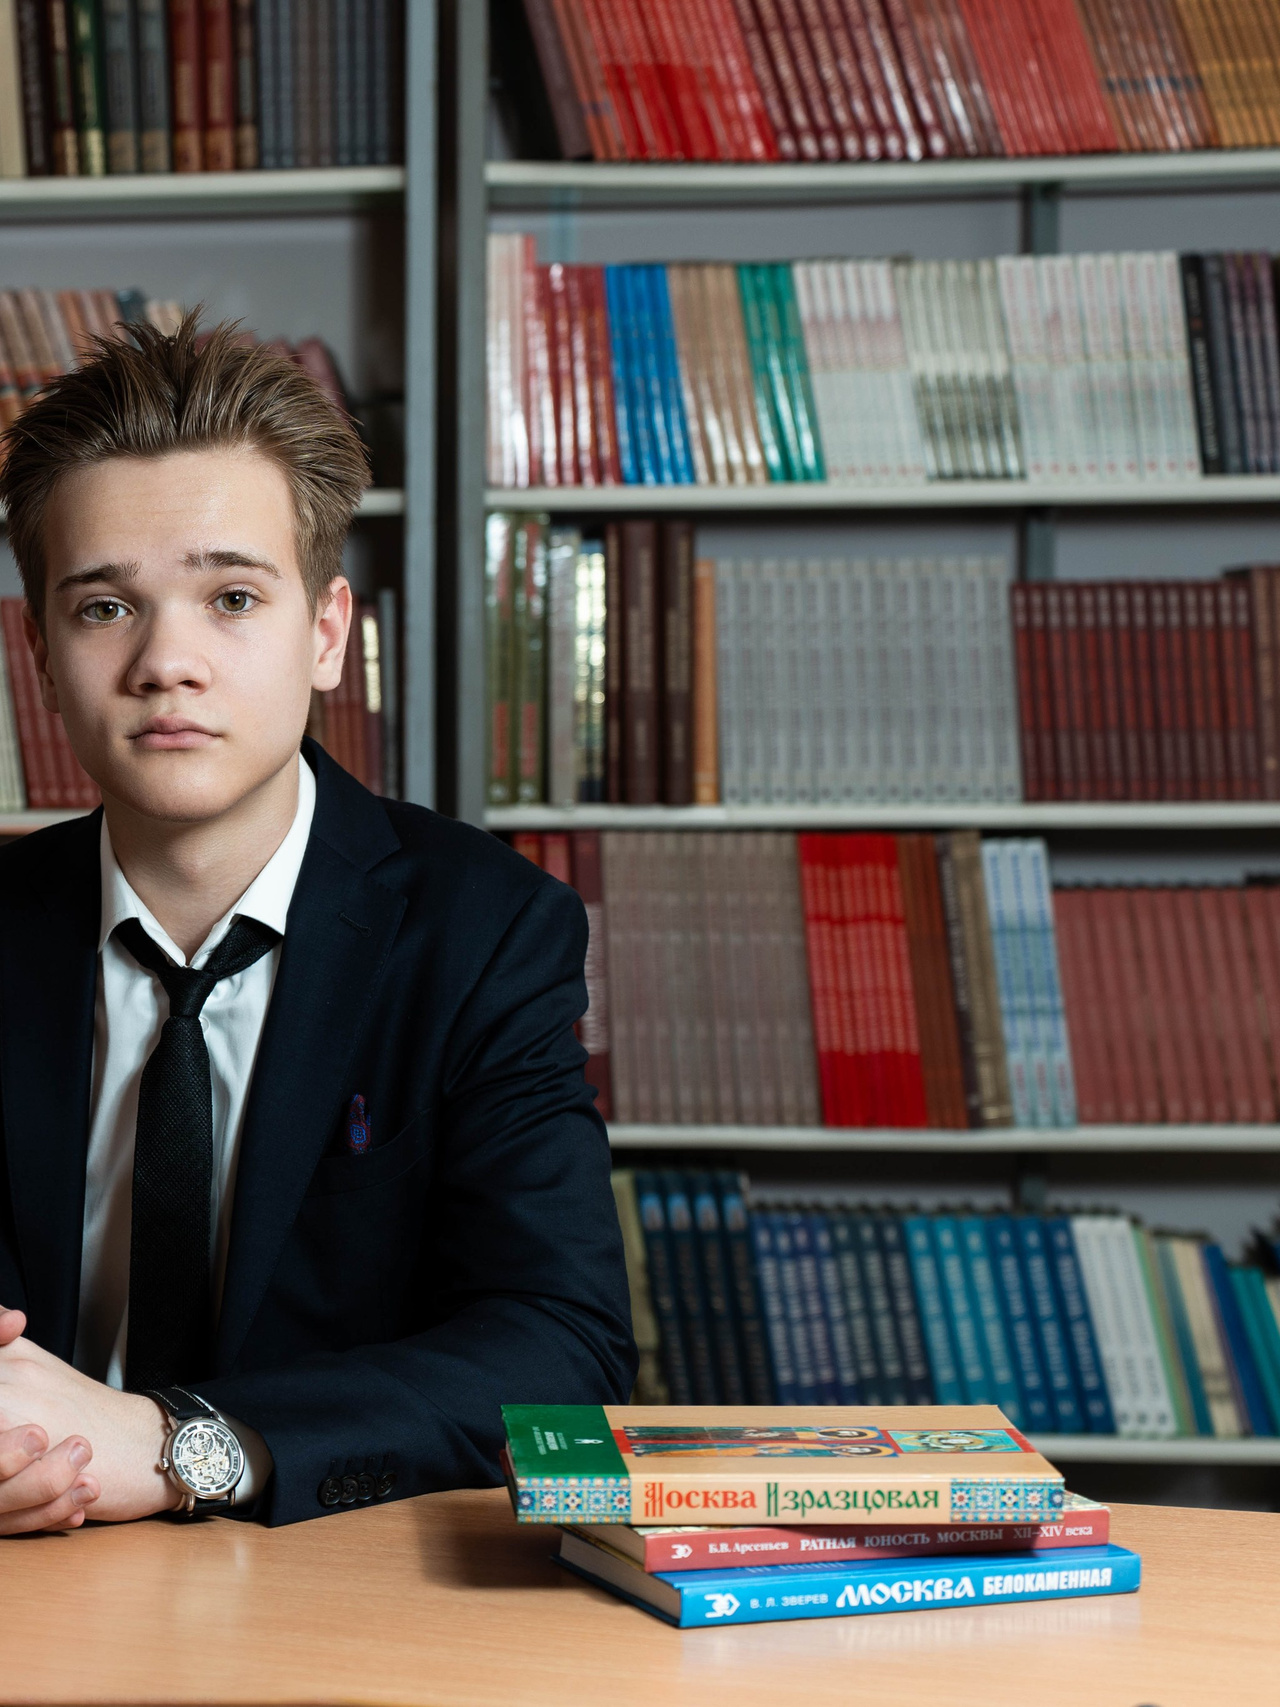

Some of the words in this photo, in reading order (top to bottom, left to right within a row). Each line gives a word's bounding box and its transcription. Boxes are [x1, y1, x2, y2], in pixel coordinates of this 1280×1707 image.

[766, 1482, 939, 1519] Изразцовая
[708, 1543, 731, 1554] Б.В.
[734, 1540, 789, 1555] Арсеньев
[800, 1537, 857, 1552] РАТНАЯ
[864, 1531, 930, 1548] ЮНОСТЬ
[936, 1529, 1003, 1544] МОСКВЫ
[1065, 1525, 1094, 1537] века
[750, 1598, 762, 1609] В.
[766, 1597, 778, 1608] Л.
[781, 1593, 829, 1607] ЗВЕРЕВ
[835, 1576, 976, 1609] МОСКВА
[983, 1567, 1112, 1596] БЕЛОКАМЕННАЯ
